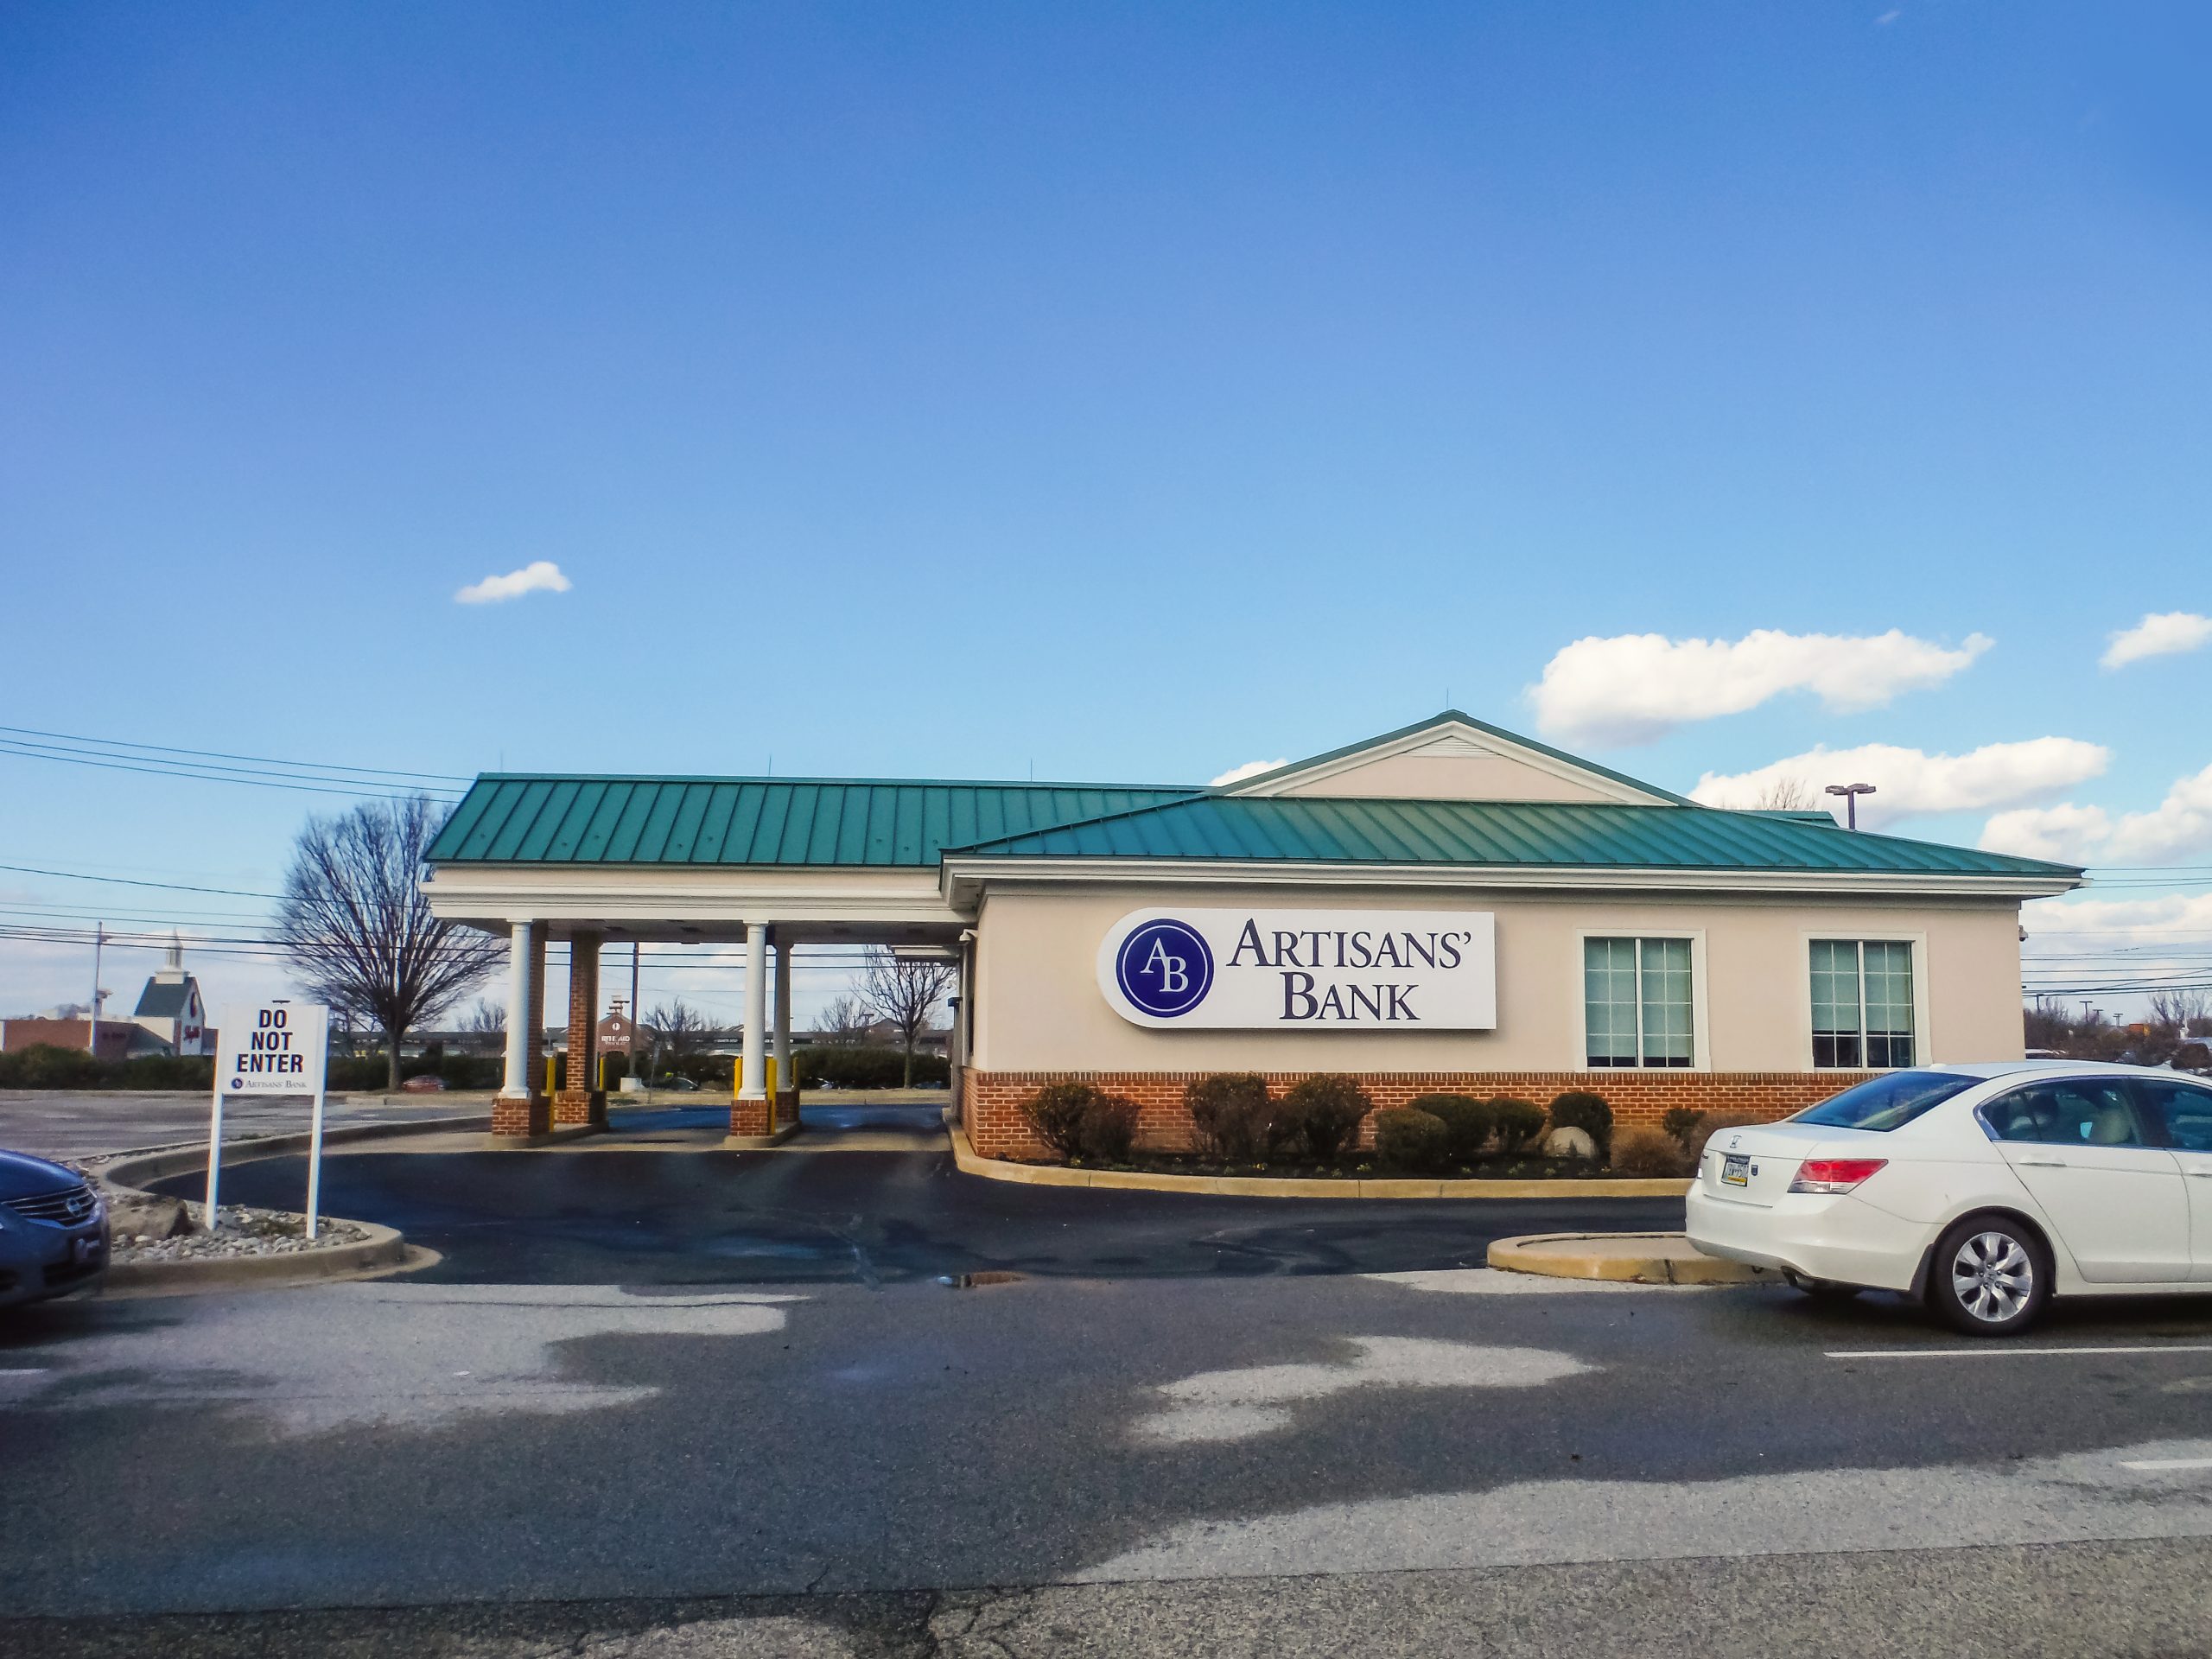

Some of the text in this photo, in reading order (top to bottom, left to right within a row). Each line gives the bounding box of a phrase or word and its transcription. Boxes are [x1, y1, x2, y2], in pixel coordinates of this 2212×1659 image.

[1279, 971, 1421, 1020] BANK
[258, 1008, 288, 1029] DO
[251, 1031, 294, 1051] NOT
[236, 1053, 304, 1073] ENTER
